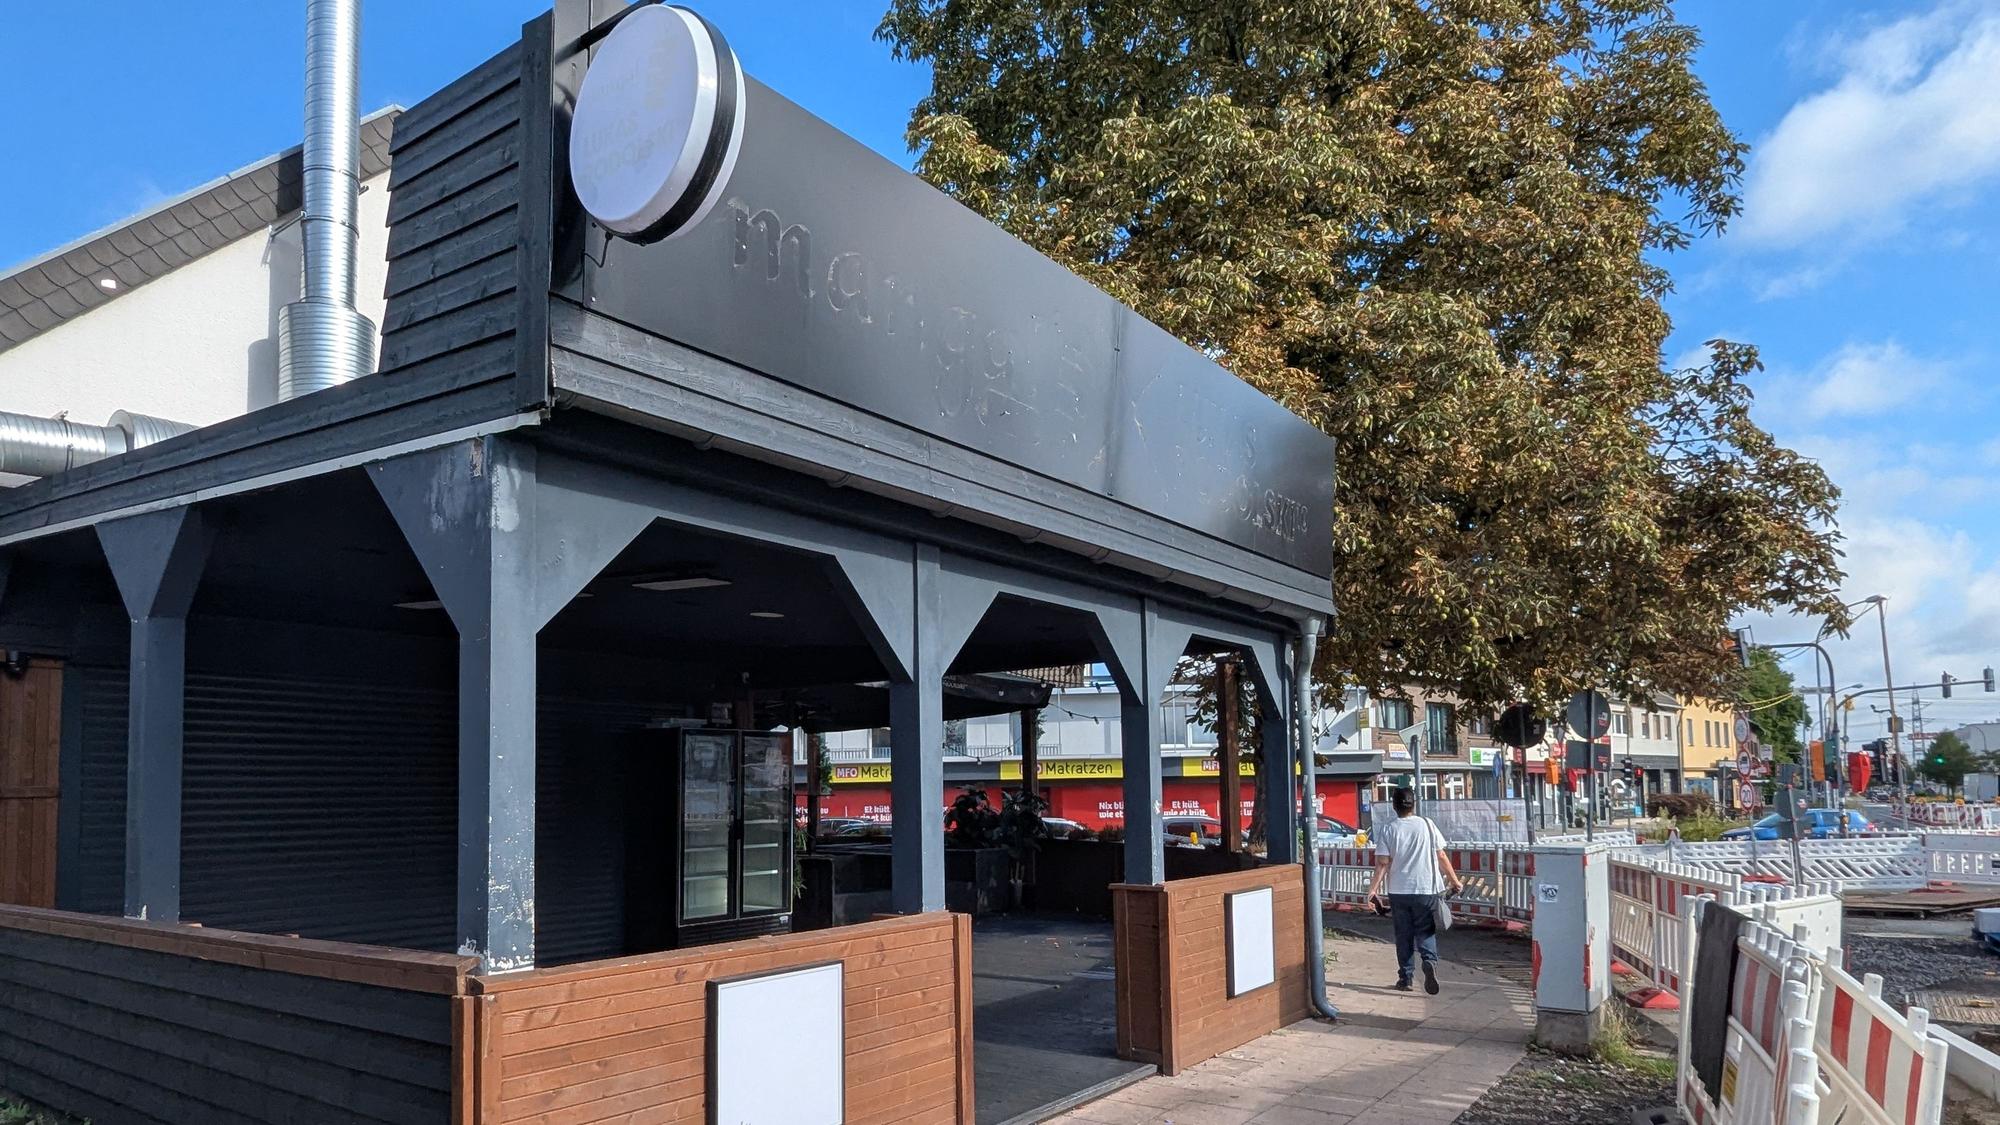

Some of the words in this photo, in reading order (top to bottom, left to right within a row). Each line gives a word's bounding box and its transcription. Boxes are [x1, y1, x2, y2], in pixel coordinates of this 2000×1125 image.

[1046, 762, 1113, 775] Matratzen
[1203, 760, 1220, 771] MF
[836, 767, 858, 778] MFO
[861, 766, 892, 778] Matr
[864, 805, 873, 813] Et
[874, 805, 890, 813] kütt
[1099, 802, 1113, 810] Nix
[1172, 801, 1181, 809] Et
[1182, 800, 1200, 809] kütt
[1099, 810, 1113, 818] wie
